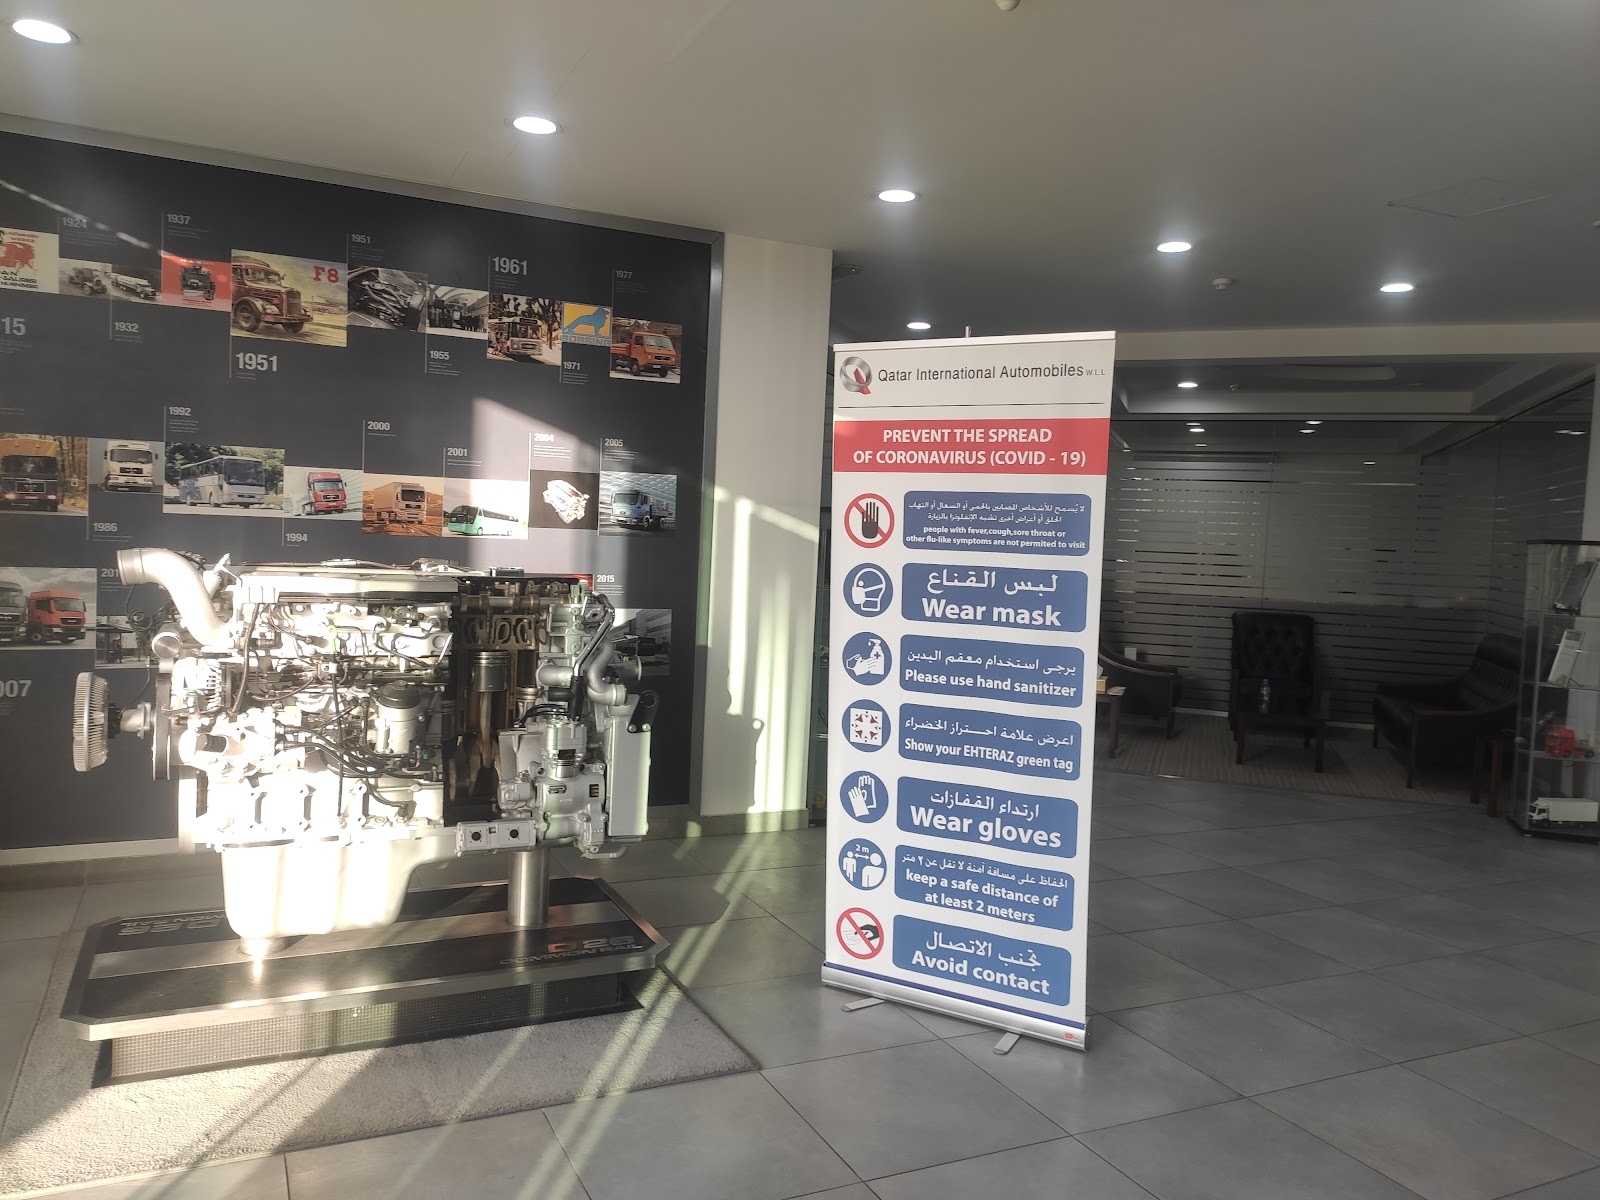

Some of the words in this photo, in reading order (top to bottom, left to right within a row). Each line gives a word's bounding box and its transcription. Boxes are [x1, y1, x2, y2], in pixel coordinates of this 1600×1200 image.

[62, 216, 88, 229] 1924
[166, 213, 191, 226] 1937
[350, 233, 371, 245] 1951
[492, 256, 528, 276] 1961
[312, 264, 340, 284] F8
[615, 269, 633, 280] 1977
[114, 321, 139, 334] 1932
[235, 352, 278, 372] 1951
[429, 350, 450, 361] 1955
[563, 360, 581, 370] 1971
[878, 368, 912, 382] Qatar
[916, 366, 996, 381] International
[999, 364, 1084, 379] Automobiles
[168, 406, 192, 418] 1992
[367, 420, 391, 432] 2000
[604, 437, 624, 448] 2005
[883, 428, 951, 443] PREVENT
[953, 428, 985, 443] THE
[988, 428, 1053, 443] SPREAD
[447, 446, 468, 458] 2001
[853, 450, 873, 464] OF
[875, 450, 987, 465] CORONAVIRUS
[989, 451, 1046, 467] (COVID
[1061, 451, 1087, 467] 19)
[93, 522, 118, 532] 1986
[923, 525, 949, 534] people
[949, 526, 967, 534] with
[1030, 528, 1056, 537] throat
[285, 532, 308, 543] 1994
[926, 535, 952, 543] flu-like
[952, 538, 992, 546] symptoms
[1020, 540, 1057, 548] permited
[1068, 541, 1086, 549] visit
[101, 568, 120, 578] 201
[596, 574, 615, 584] 2015
[926, 568, 997, 595] القناع
[1004, 573, 1059, 597] لبس
[921, 597, 986, 621] Wear
[992, 604, 1062, 627] mask
[907, 649, 942, 664] اليدين
[945, 652, 983, 666] معقم
[985, 654, 1040, 670] استخدام
[0, 679, 32, 698] 07
[905, 668, 947, 685] Please
[950, 673, 974, 687] use
[976, 675, 1011, 691] hand
[1013, 681, 1077, 697] sanitizer
[905, 716, 947, 731] الخضراء
[1000, 726, 1034, 742] علامة
[1037, 734, 1074, 748] اعرض
[904, 737, 934, 752] Show
[935, 743, 962, 757] your
[963, 744, 1015, 764] EHTERAZ
[1016, 754, 1051, 768] green
[1053, 757, 1074, 773] tag
[930, 790, 995, 811] القفازات
[998, 799, 1040, 822] ارتداء
[910, 805, 973, 833] Wear
[978, 817, 1062, 848] gloves
[855, 843, 861, 852] 2
[924, 858, 938, 868] عن
[986, 865, 1016, 881] مسافة
[1017, 873, 1036, 886] على
[905, 868, 938, 888] keep
[939, 877, 949, 888] a
[951, 878, 980, 893] safe
[981, 884, 1040, 905] distance
[1042, 894, 1059, 908] of
[1038, 875, 1068, 889] الحفاظ
[924, 892, 939, 904] at
[941, 893, 974, 910] least
[975, 899, 985, 913] 2
[987, 903, 1036, 923] meters
[925, 930, 992, 958] الاتصال
[500, 949, 597, 966] COMMON
[998, 948, 1042, 972] تجنب
[911, 950, 969, 977] Avoid
[972, 966, 1050, 996] contact
